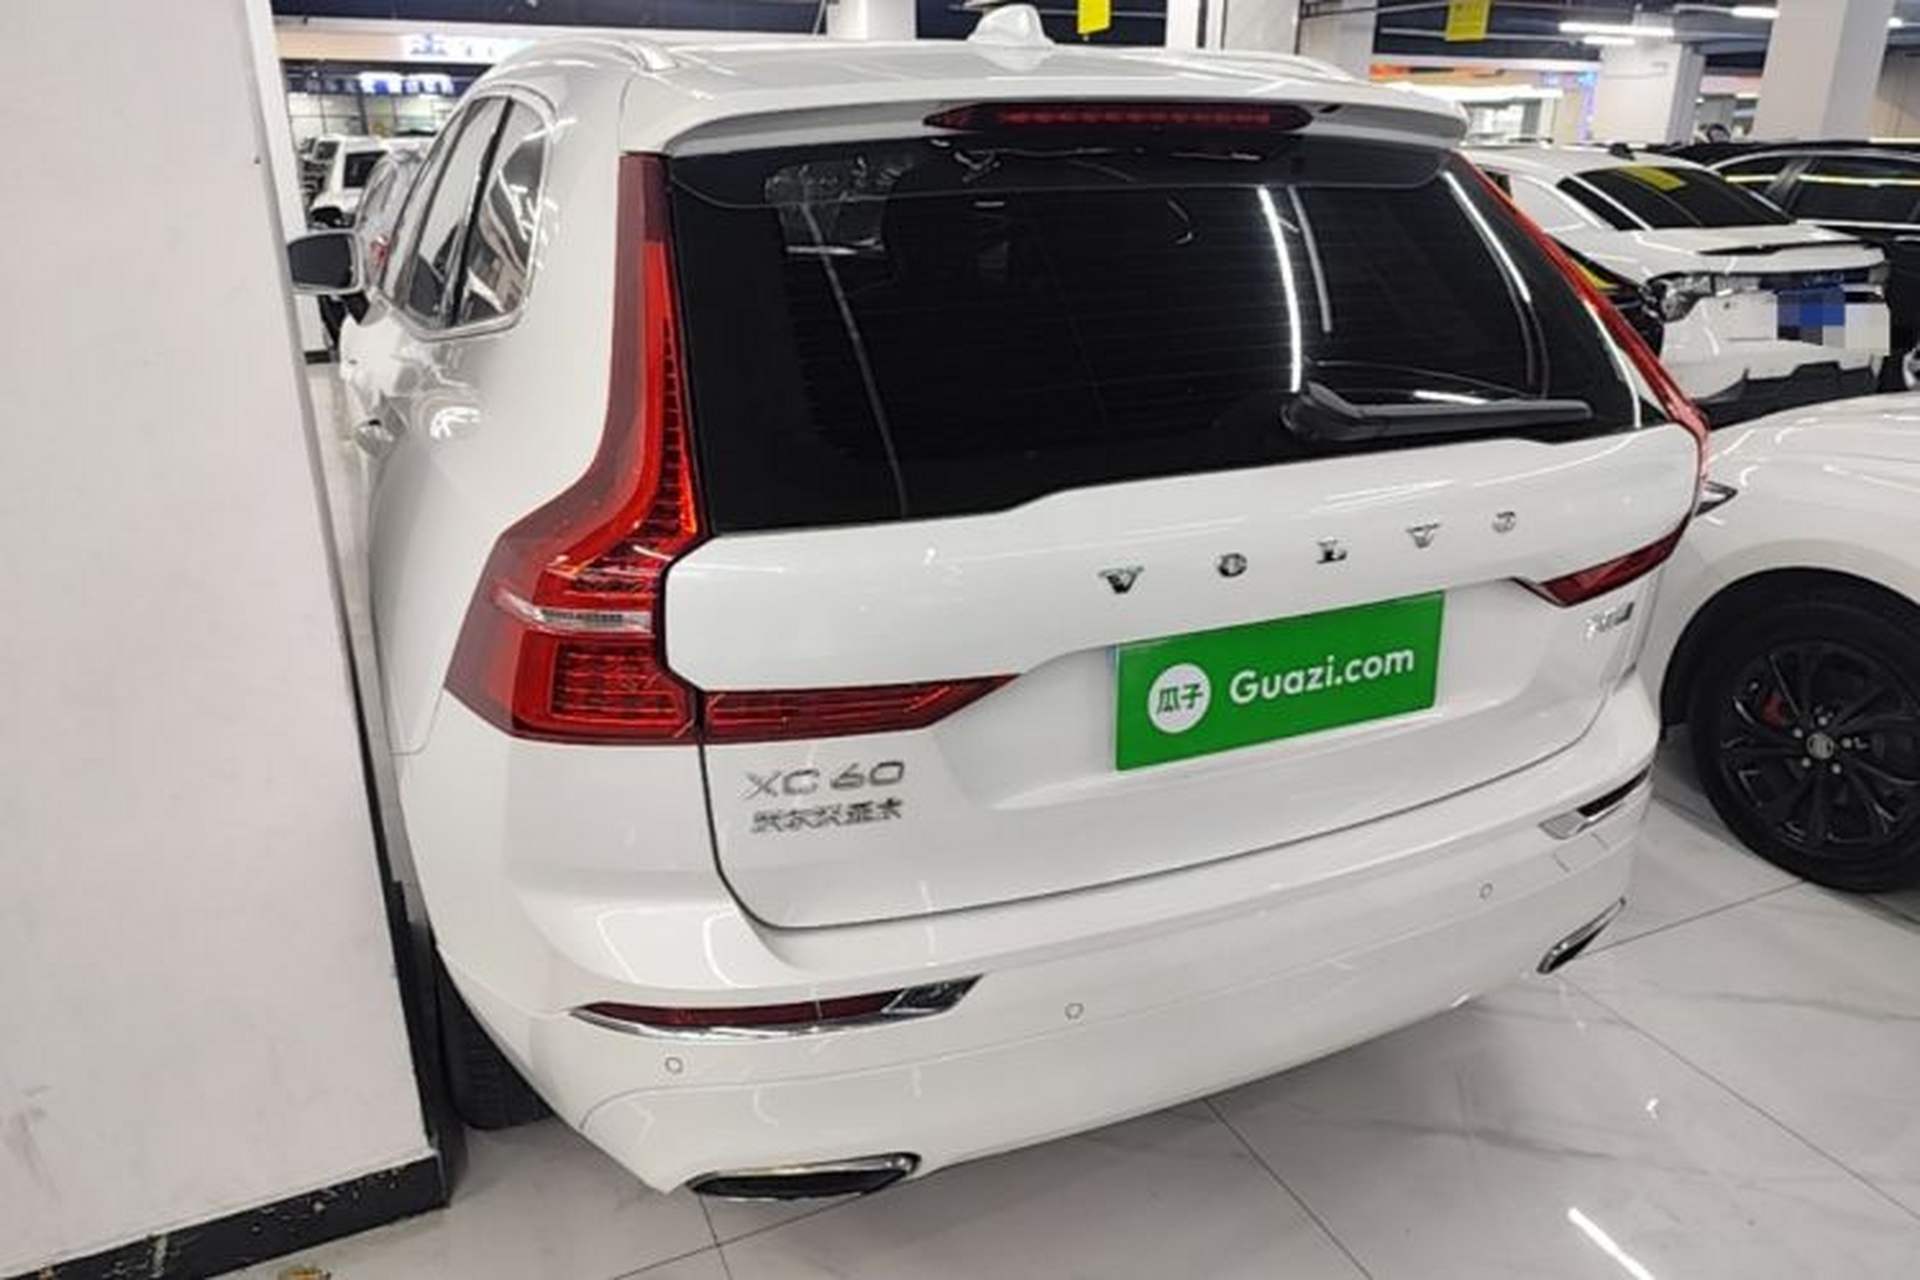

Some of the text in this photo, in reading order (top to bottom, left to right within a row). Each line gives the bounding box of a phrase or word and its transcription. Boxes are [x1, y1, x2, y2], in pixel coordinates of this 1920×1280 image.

[1097, 511, 1517, 594] VOLVO
[1157, 681, 1204, 715] 瓜子
[1230, 648, 1415, 704] Guazi.com
